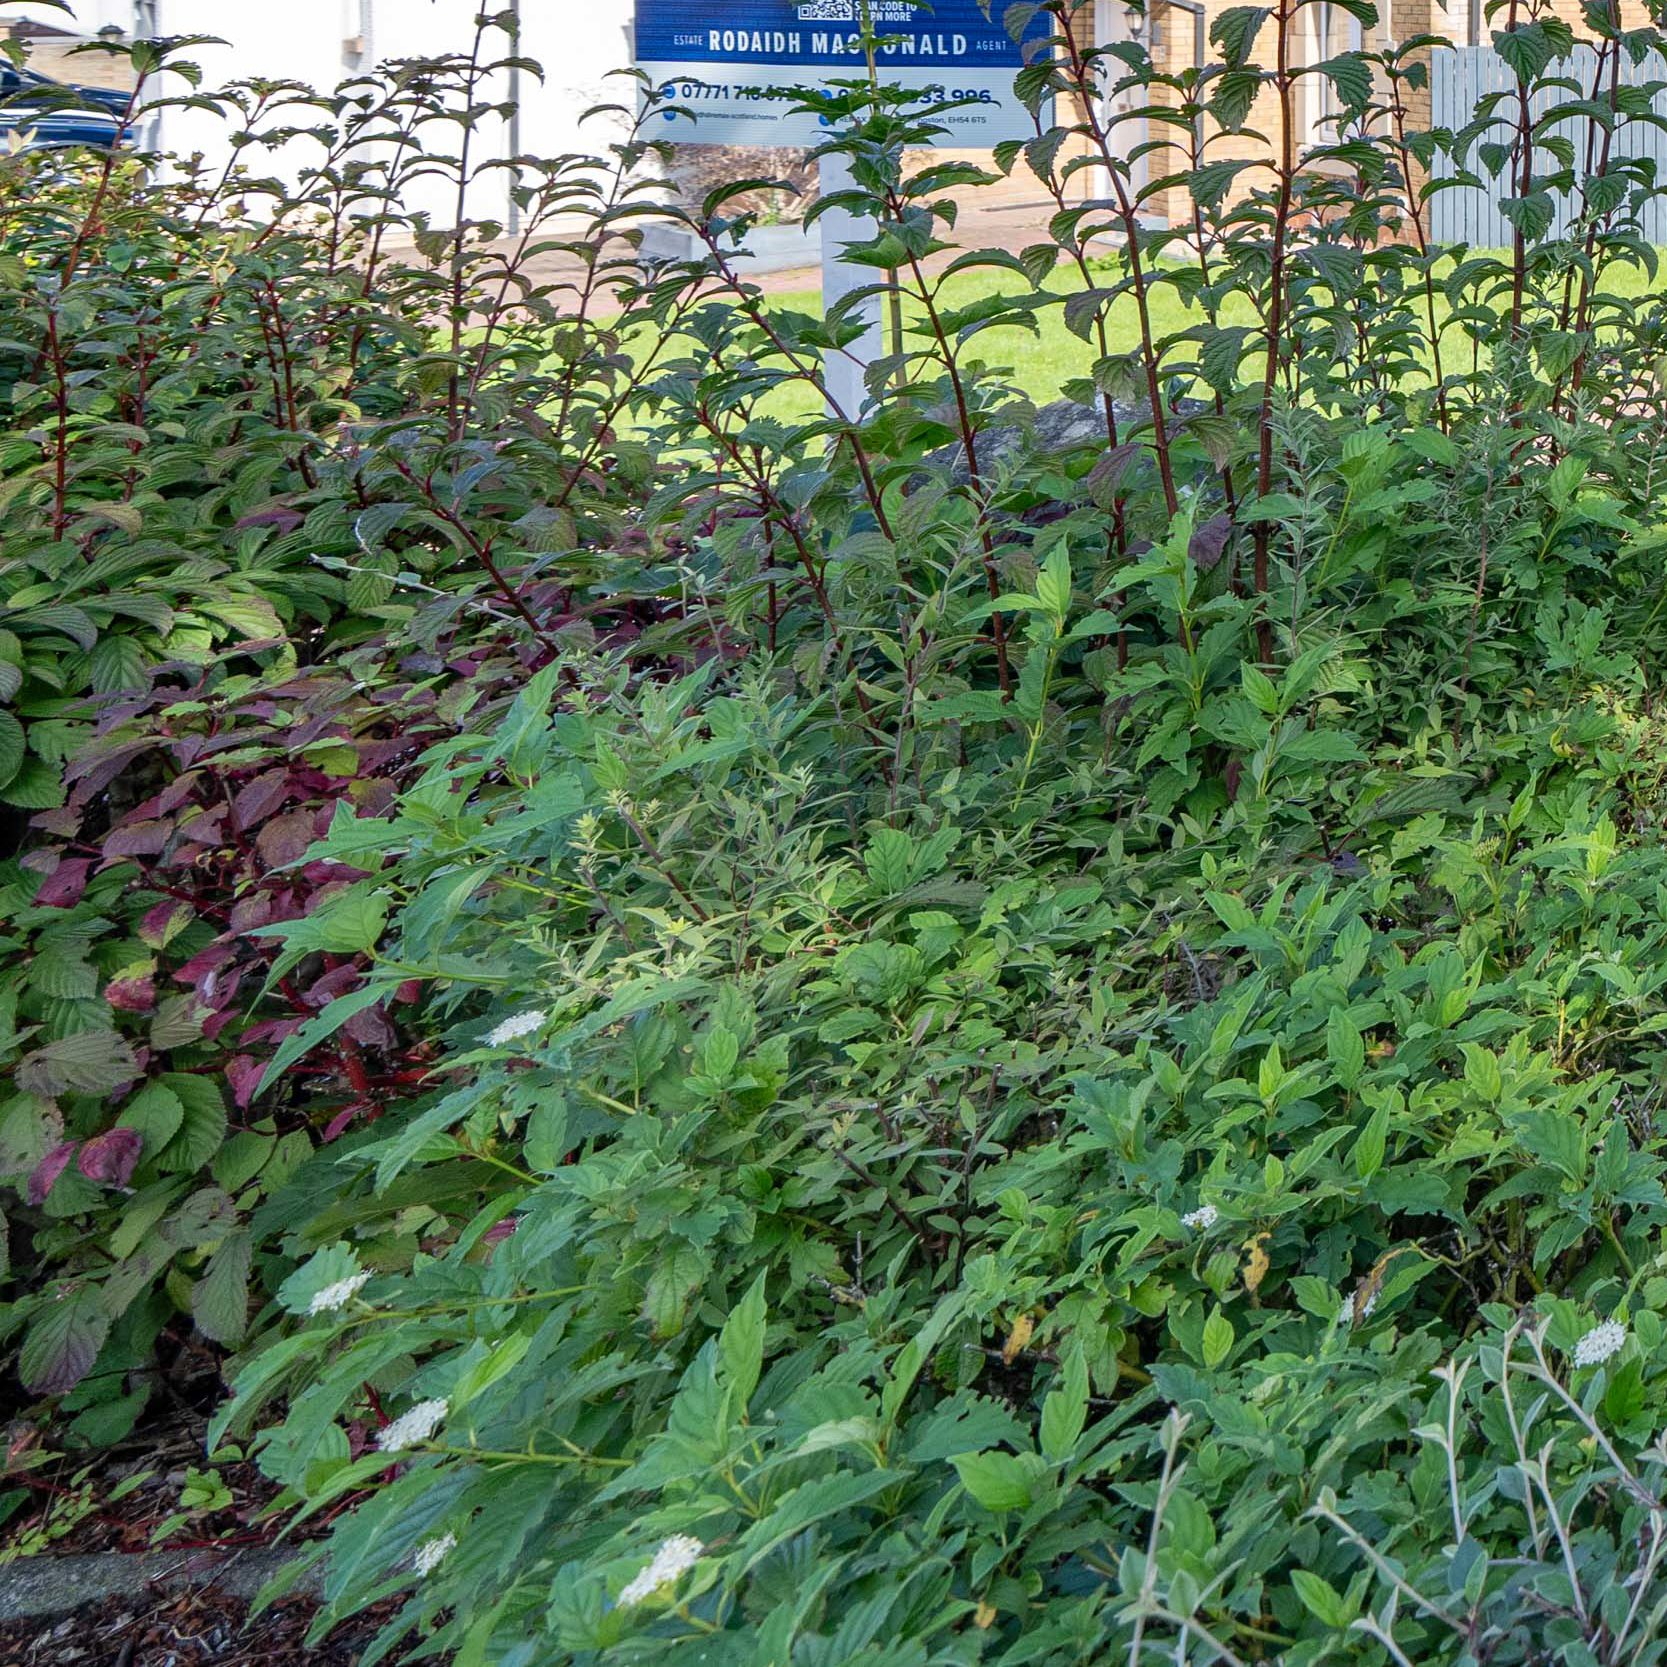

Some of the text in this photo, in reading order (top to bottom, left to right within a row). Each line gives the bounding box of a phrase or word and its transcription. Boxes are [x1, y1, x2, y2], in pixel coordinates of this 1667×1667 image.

[885, 11, 912, 22] MORE
[674, 35, 703, 46] ESTATE
[709, 30, 801, 54] RODAIDH
[976, 40, 1007, 51] AGENT
[681, 84, 729, 100] 07771
[948, 116, 970, 124] EH54
